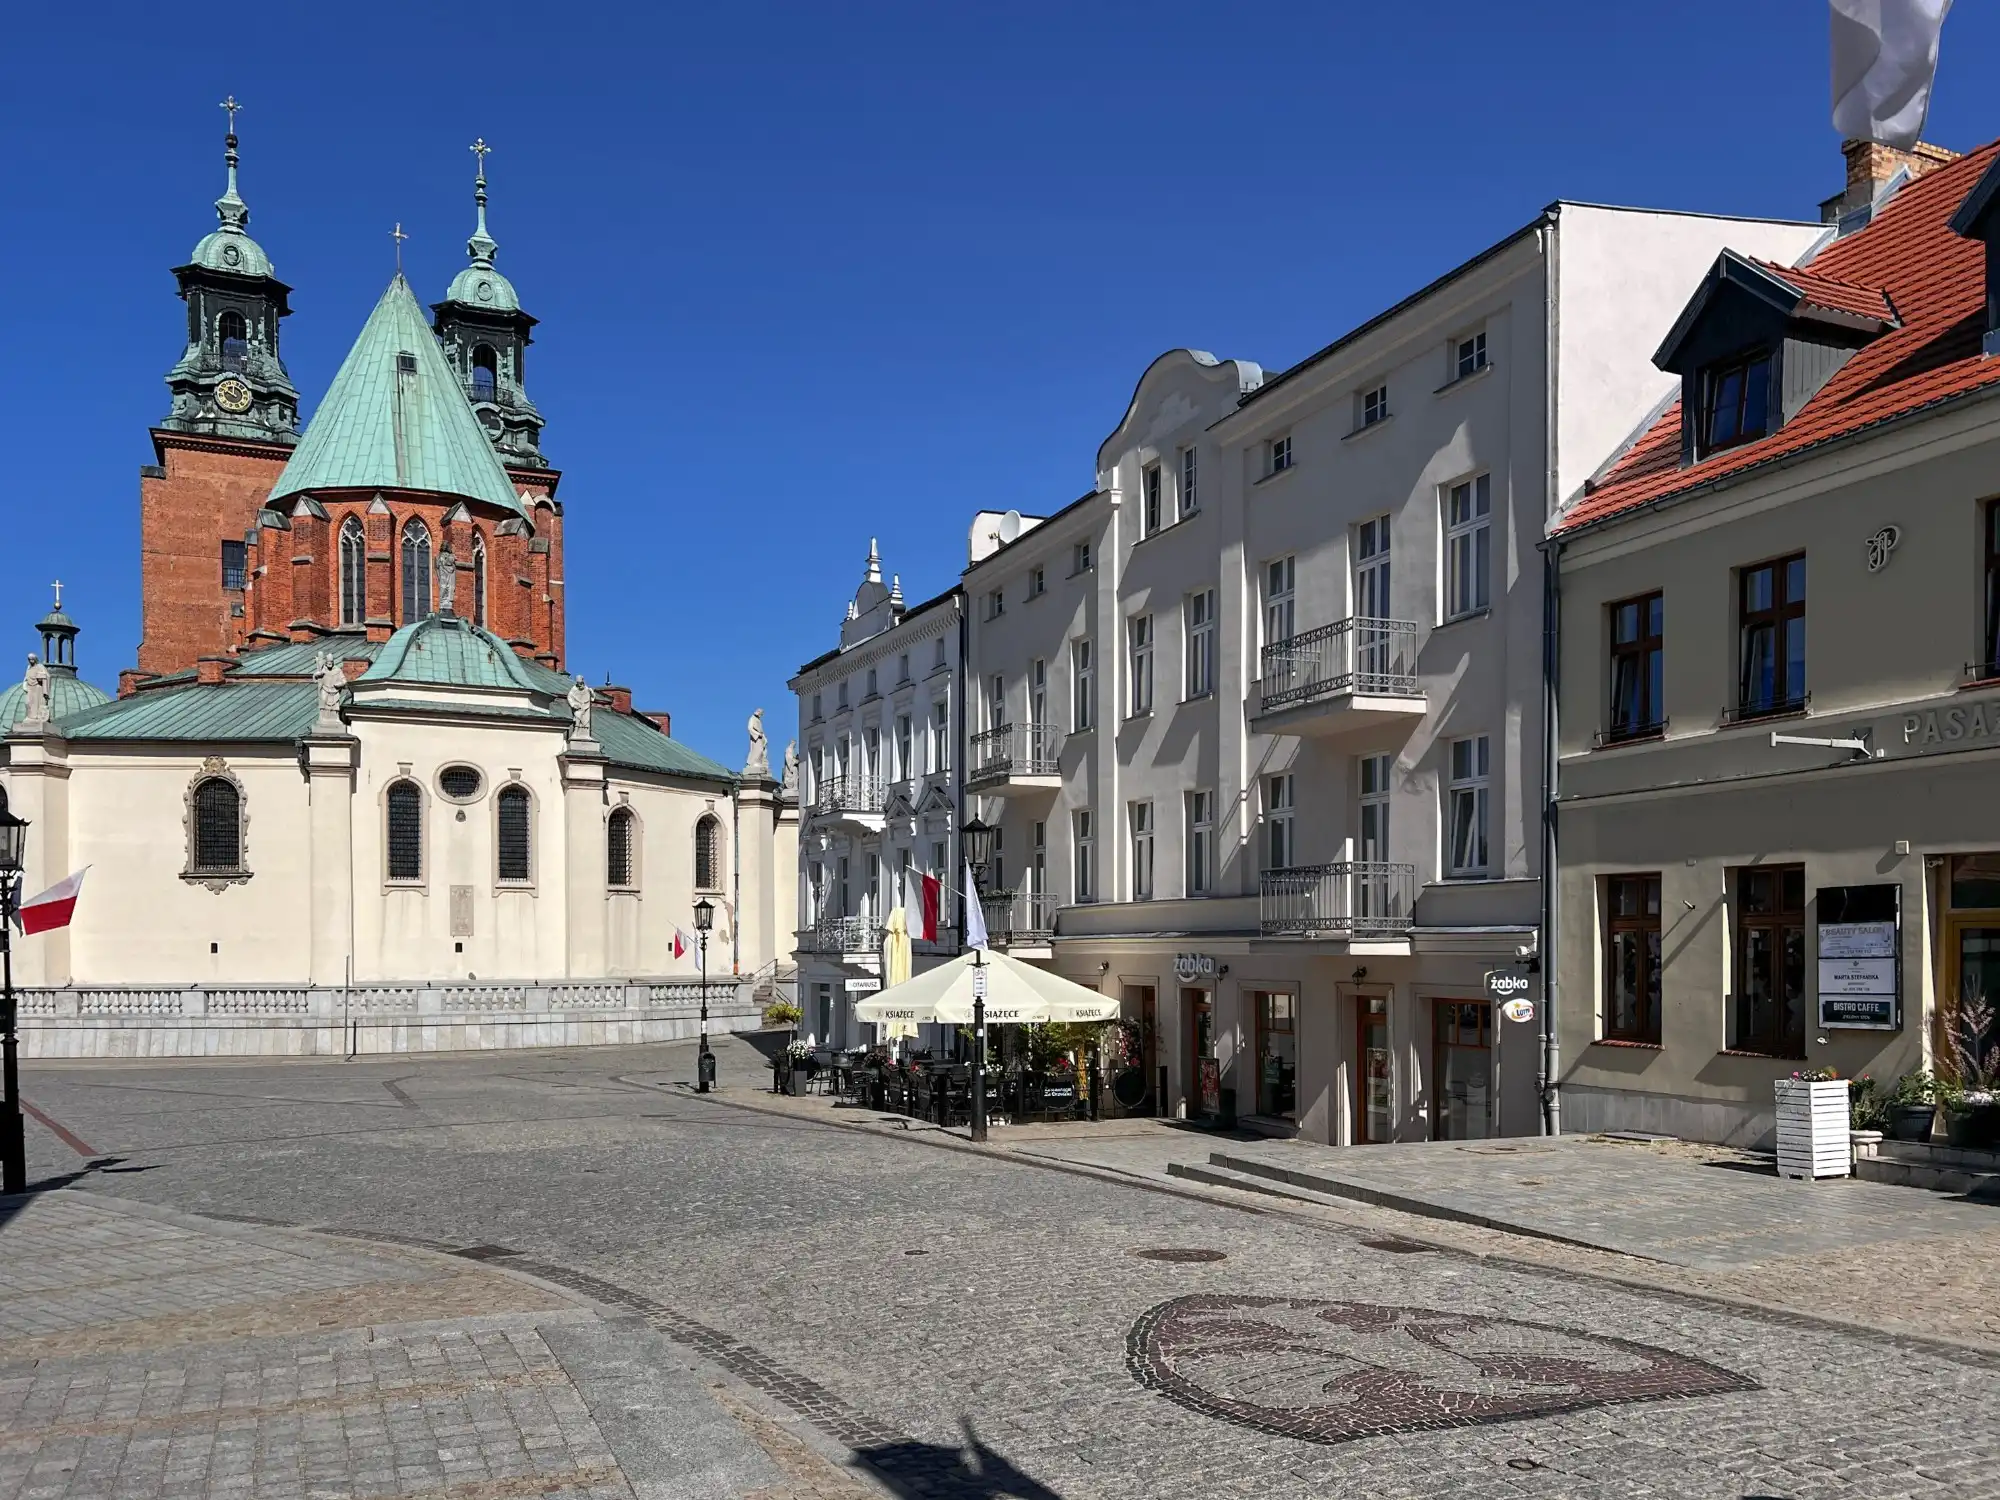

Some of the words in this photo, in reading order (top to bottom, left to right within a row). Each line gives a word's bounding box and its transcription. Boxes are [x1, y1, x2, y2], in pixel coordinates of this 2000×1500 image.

[1173, 952, 1215, 973] żabka
[1490, 976, 1529, 989] żabka
[1833, 1002, 1856, 1011] BISTRO
[1857, 1003, 1880, 1012] CAFFE
[983, 1009, 1019, 1019] SIĄŻĘCE
